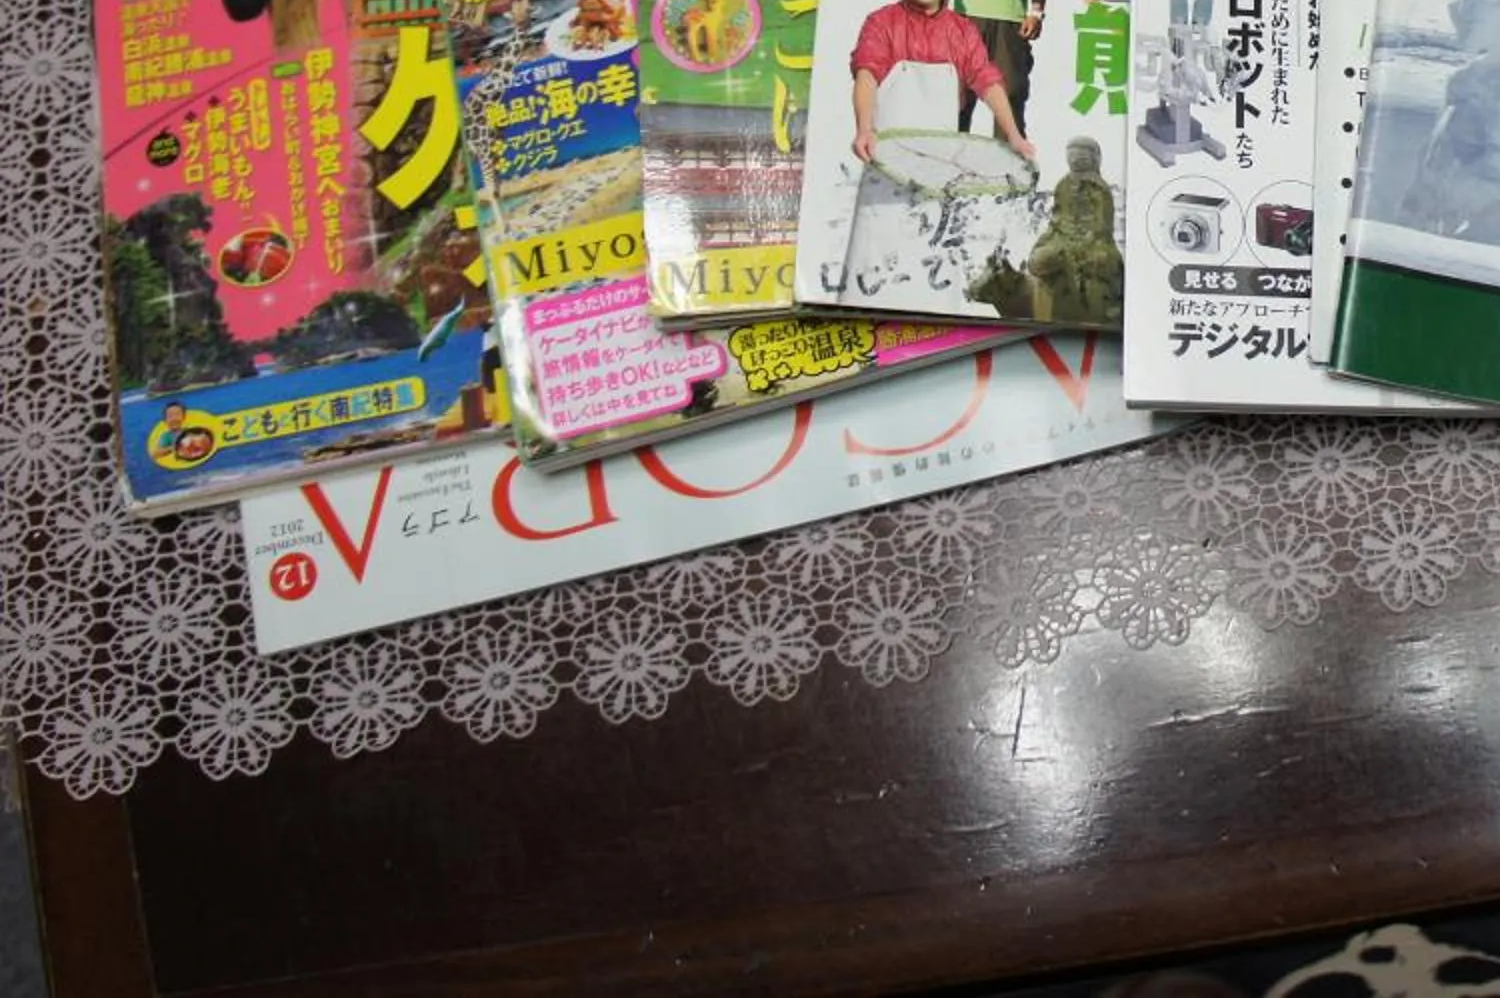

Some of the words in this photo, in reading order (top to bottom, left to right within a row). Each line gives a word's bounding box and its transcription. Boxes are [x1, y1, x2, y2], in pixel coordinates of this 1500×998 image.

[505, 231, 647, 287] Miyo
[1183, 269, 1238, 290] 見せる
[1167, 321, 1311, 360] デジタル
[271, 518, 306, 538] 2012
[402, 502, 480, 538] アゴラ
[275, 560, 310, 591] 12
